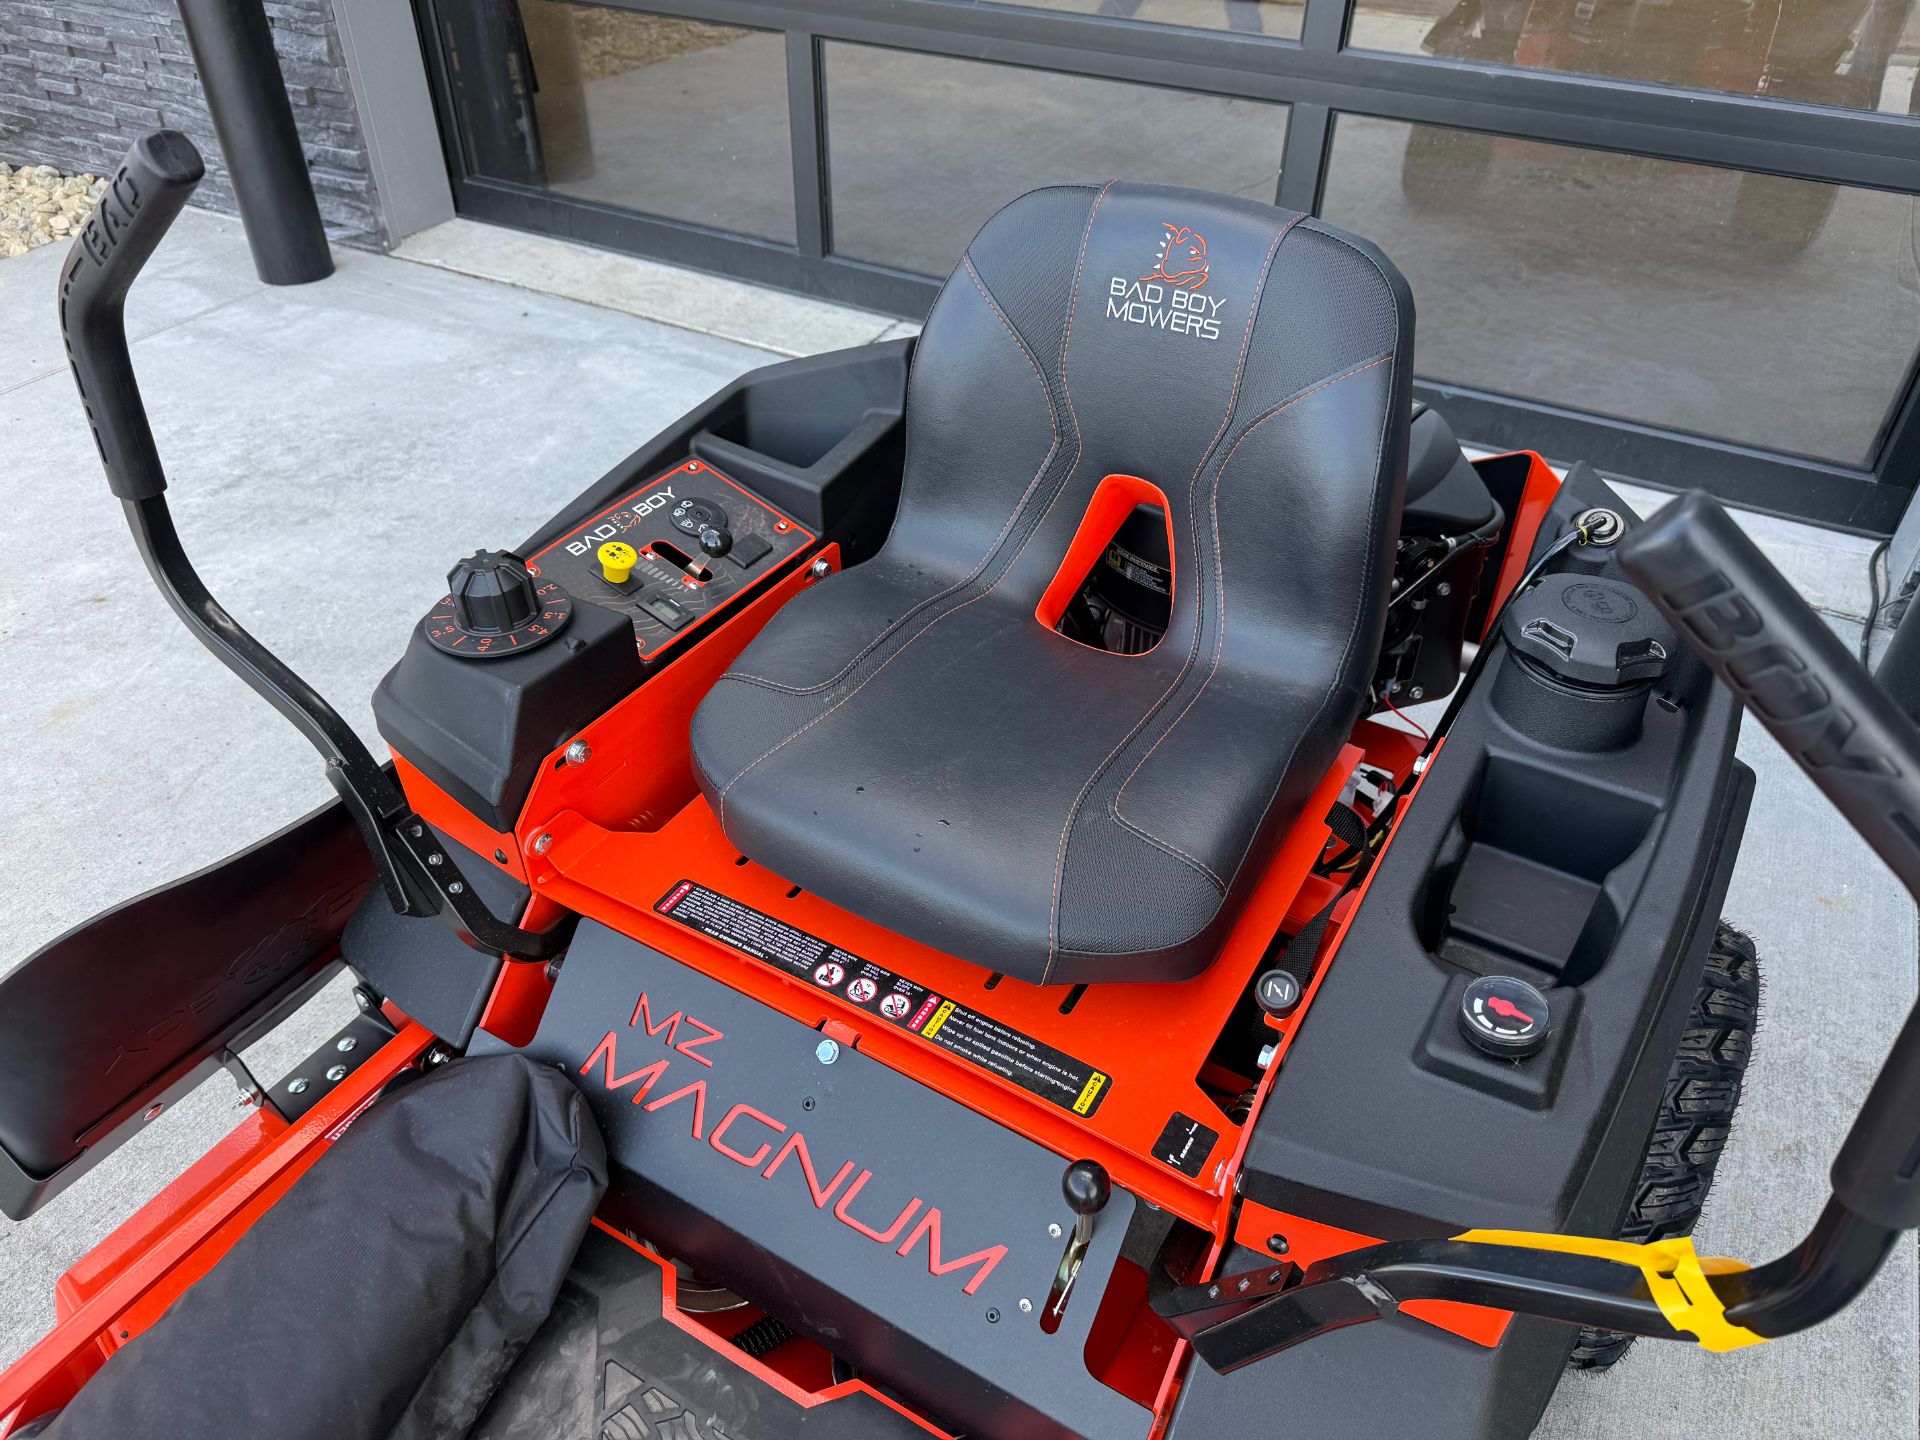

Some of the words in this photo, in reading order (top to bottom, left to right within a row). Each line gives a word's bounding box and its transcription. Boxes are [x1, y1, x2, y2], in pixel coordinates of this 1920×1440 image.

[1106, 297, 1221, 340] MOWERS
[1110, 277, 1163, 304] BAD
[1172, 289, 1226, 317] BOY
[565, 523, 617, 556] BAD
[632, 486, 676, 517] BOY
[1661, 570, 1903, 778] BOY
[629, 992, 724, 1068] MZ
[911, 1002, 932, 1029] DANGER
[925, 1009, 947, 1036] CAUTION
[941, 1024, 956, 1034] Wipe
[971, 1039, 990, 1051] spilled
[990, 1048, 1014, 1063] gasoline
[1015, 1060, 1033, 1072] before
[943, 1038, 953, 1046] not
[953, 1043, 972, 1055] smoke
[972, 1052, 987, 1062] while
[948, 1015, 965, 1025] Never
[973, 1026, 983, 1034] fuel
[996, 1038, 1018, 1051] indoors
[1025, 1052, 1041, 1062] when
[1041, 1060, 1061, 1073] engine
[1077, 1081, 1097, 1111] CAUTION
[579, 1030, 1008, 1296] MAGNUM
